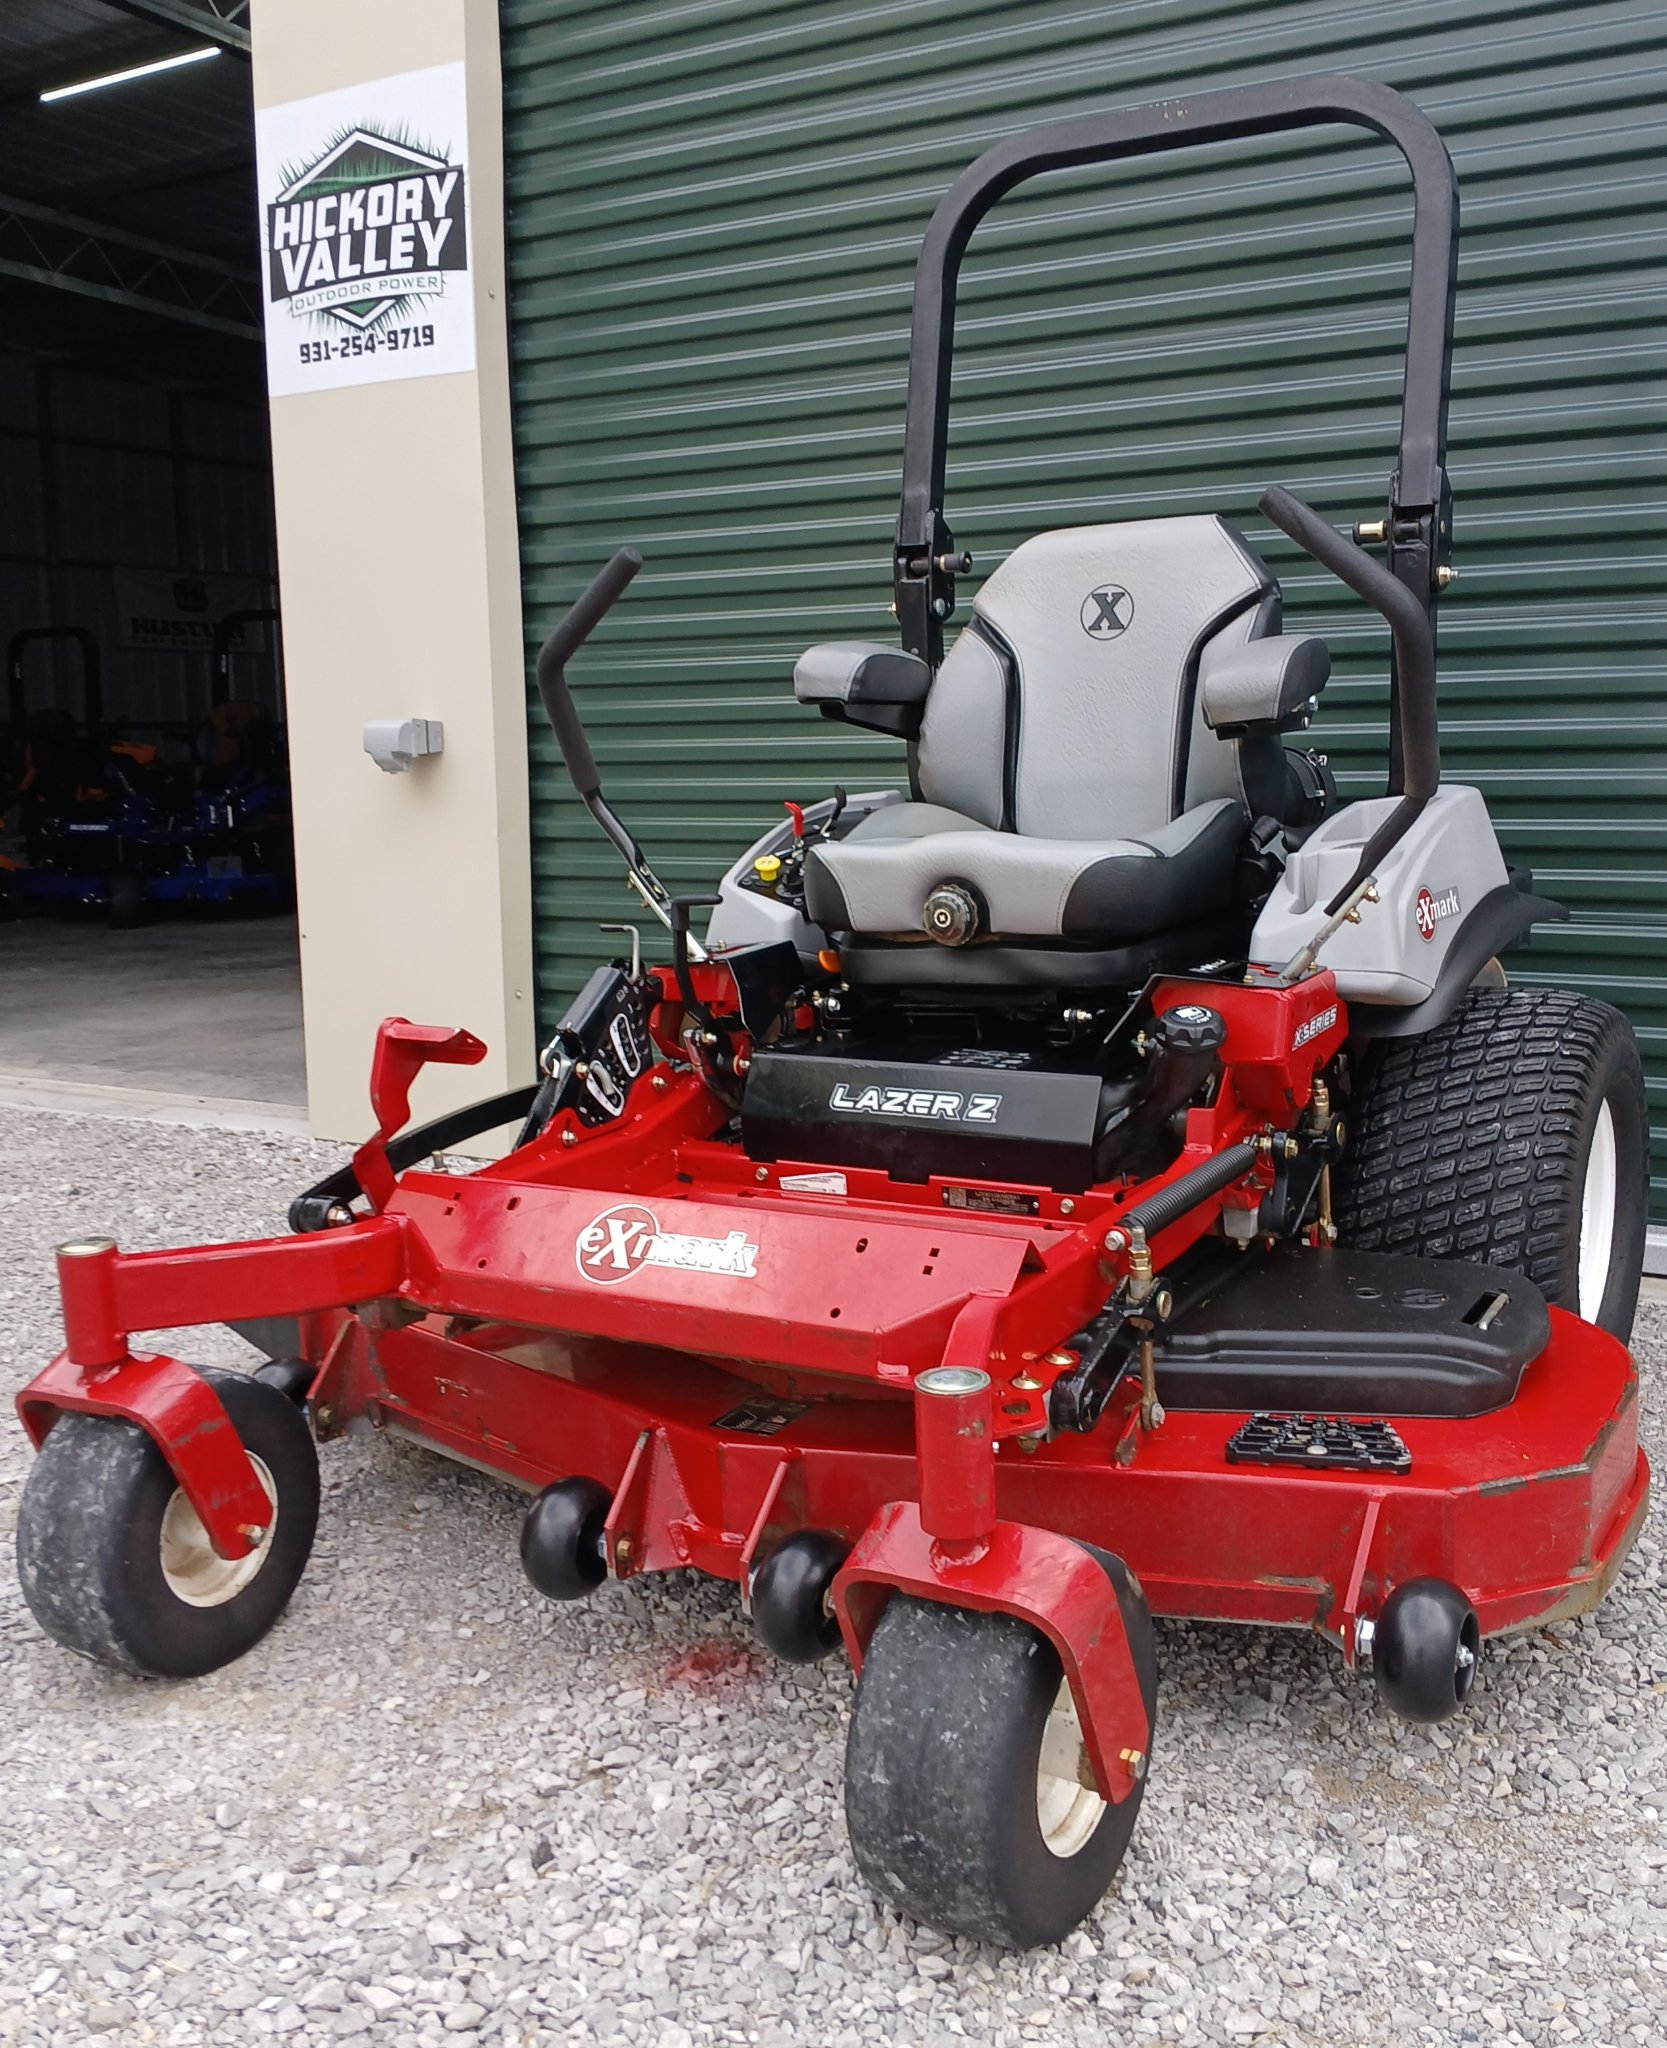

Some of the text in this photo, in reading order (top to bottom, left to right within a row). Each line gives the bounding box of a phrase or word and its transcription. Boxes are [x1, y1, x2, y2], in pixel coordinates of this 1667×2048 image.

[273, 170, 459, 251] HICKORY
[279, 217, 453, 293] VALLEY
[294, 275, 438, 311] OUTDOOR POWER
[299, 324, 435, 364] 931-254-9719
[1087, 591, 1127, 632] X
[831, 1085, 1000, 1120] LAZER Z
